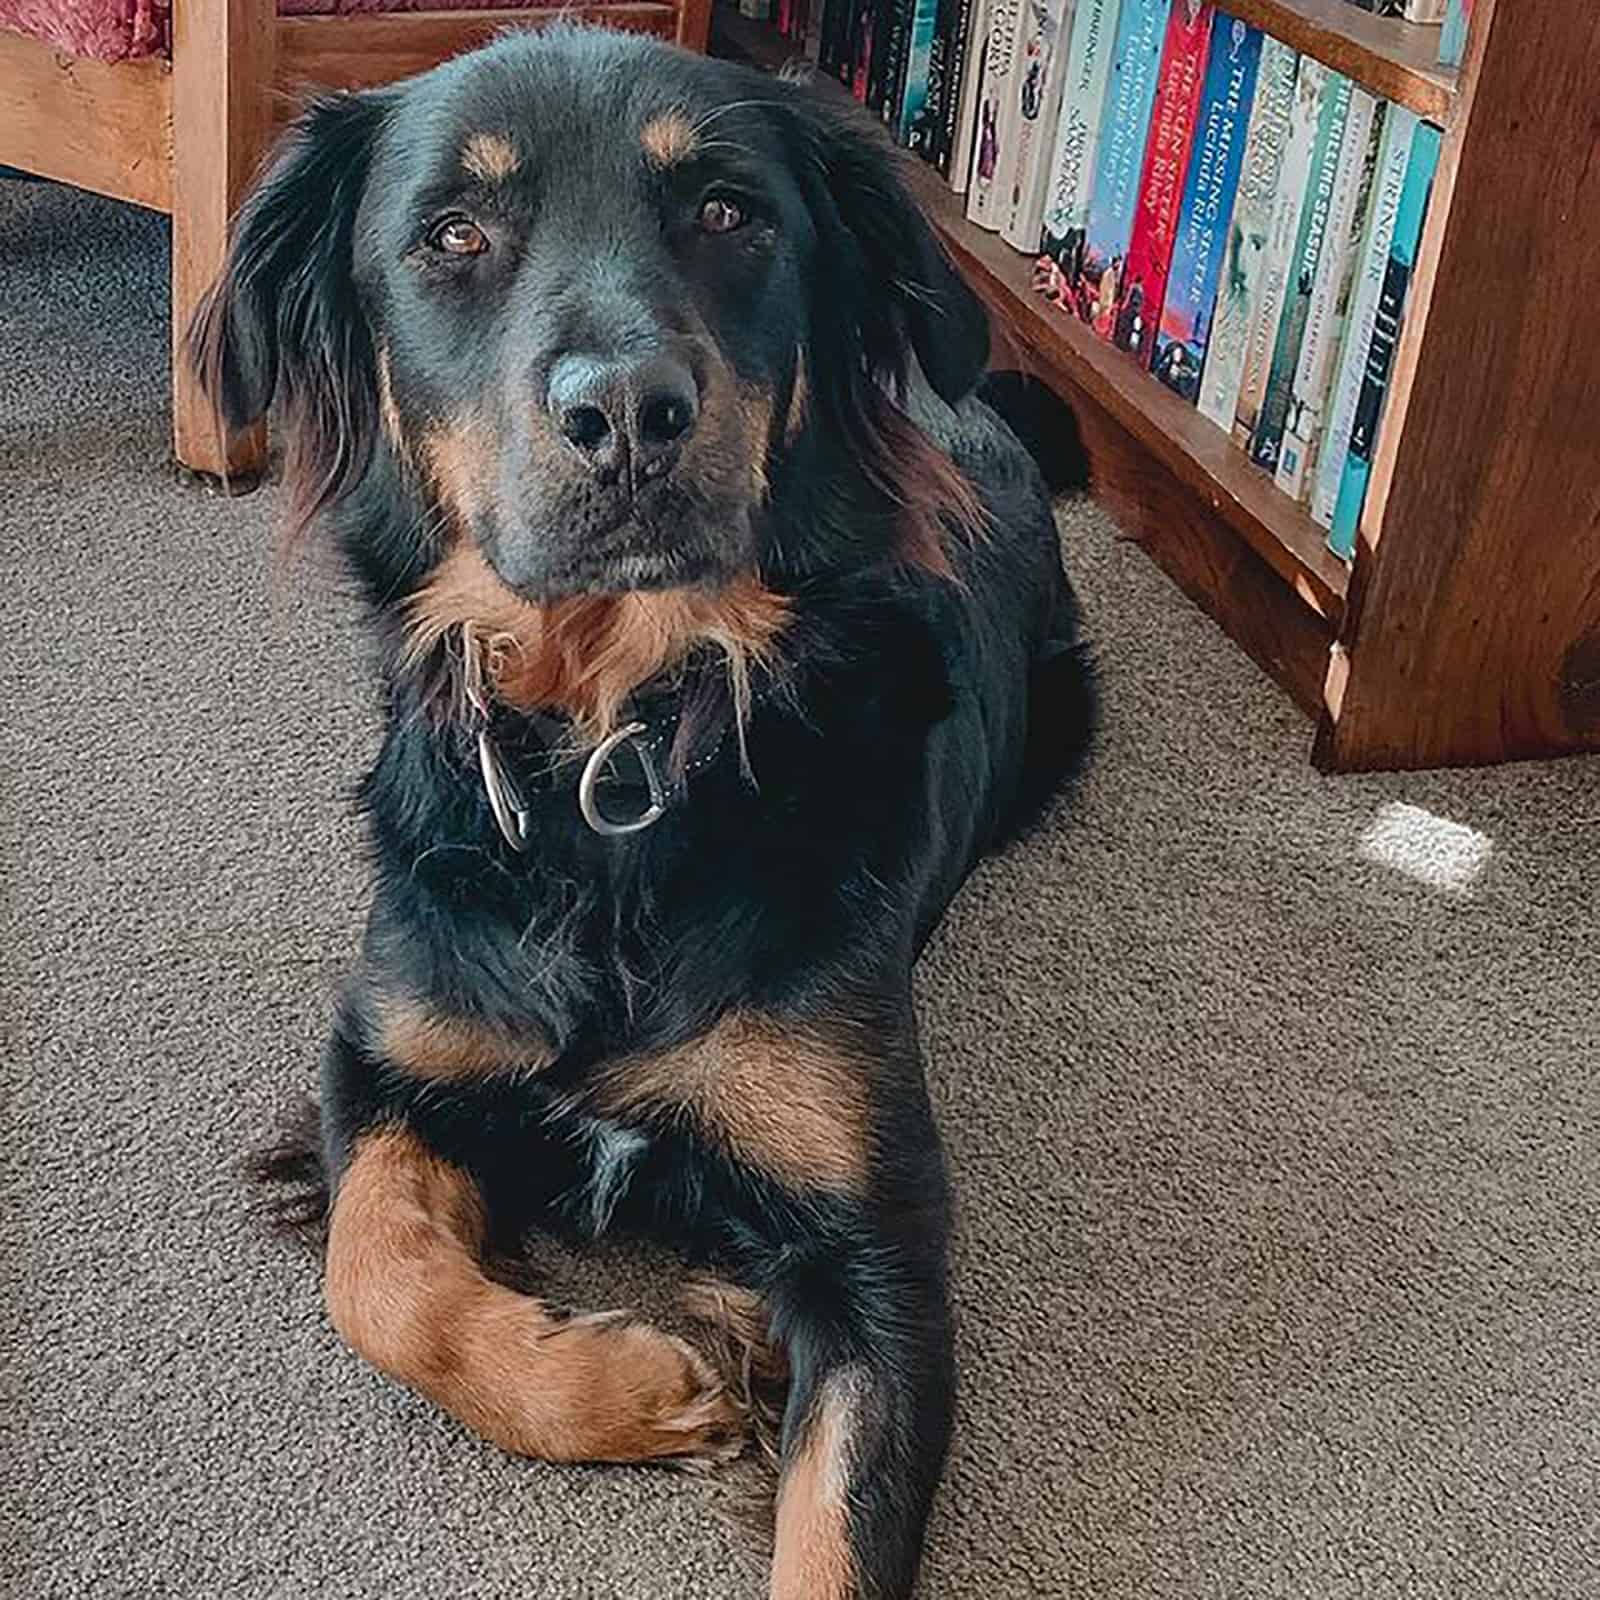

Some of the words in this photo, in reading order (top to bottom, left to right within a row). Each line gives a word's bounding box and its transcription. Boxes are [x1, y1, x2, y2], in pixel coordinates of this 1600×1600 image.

[1114, 34, 1141, 121] Lucinda
[1126, 62, 1148, 139] MOON
[1156, 59, 1183, 150] Lucinda
[1180, 51, 1199, 96] THE
[1226, 66, 1246, 113] THE
[1103, 129, 1125, 184] Riley
[1171, 100, 1189, 155] SUN
[1196, 101, 1224, 192] Lucinda
[1319, 117, 1345, 197] KILLING
[1112, 146, 1133, 219] SISTER
[1143, 155, 1168, 214] Riley
[1206, 117, 1234, 221] MISSING
[1183, 197, 1206, 256] Riley
[1367, 147, 1404, 281] STRINGER
[1190, 225, 1213, 304] SISTER
